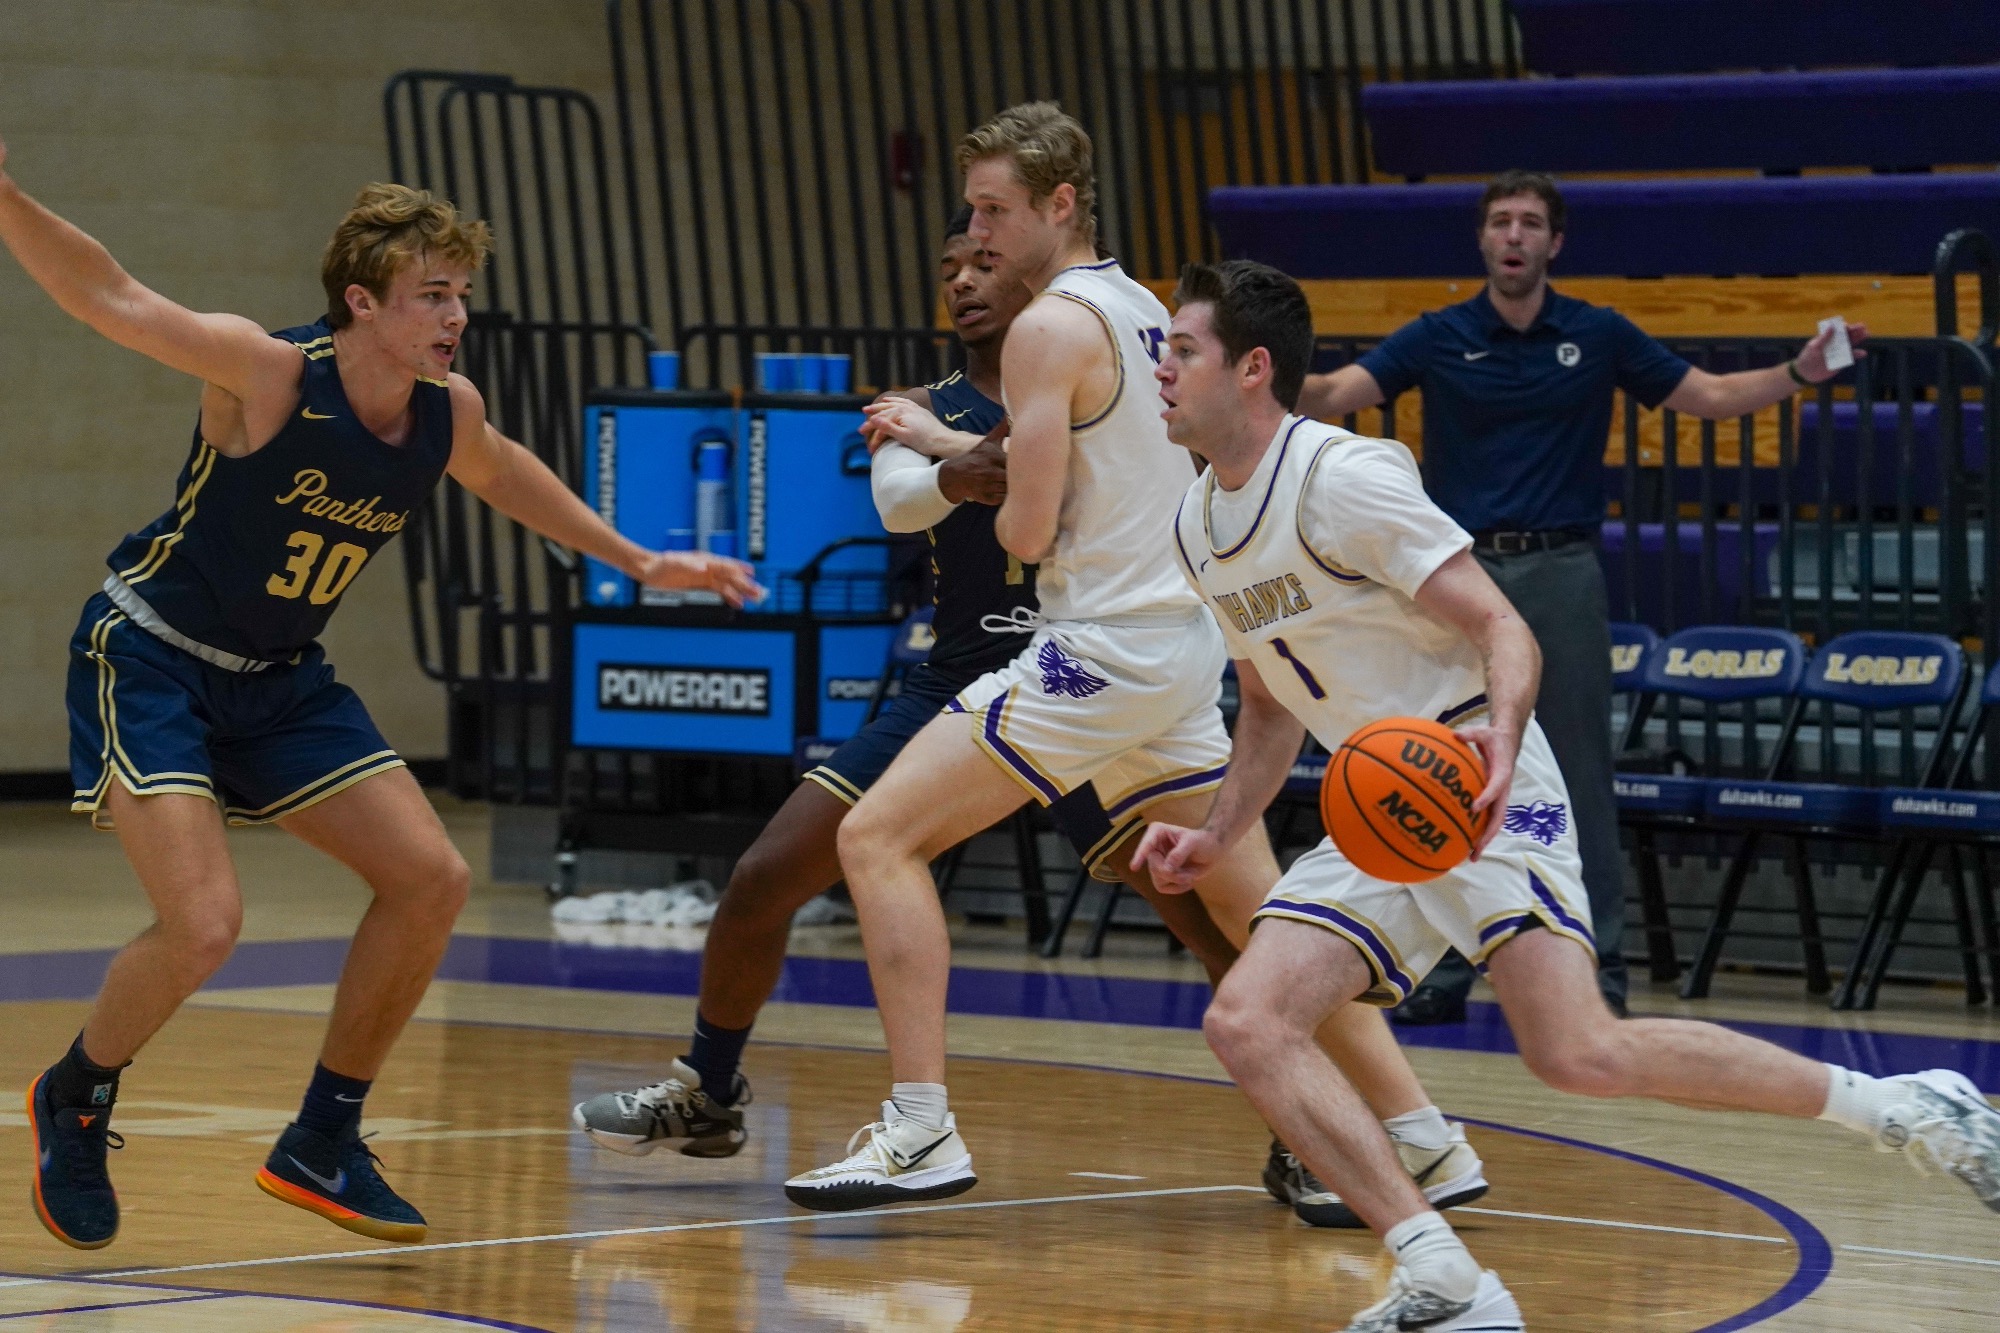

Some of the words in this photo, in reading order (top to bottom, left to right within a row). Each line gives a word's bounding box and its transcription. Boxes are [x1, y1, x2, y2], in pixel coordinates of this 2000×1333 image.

[275, 468, 409, 532] Panthers
[266, 530, 368, 605] 30
[601, 669, 768, 711] POWERADE
[1268, 637, 1327, 700] 1
[1665, 648, 1785, 680] LORAS
[1824, 653, 1942, 685] LORAS
[1378, 789, 1449, 853] NCAA
